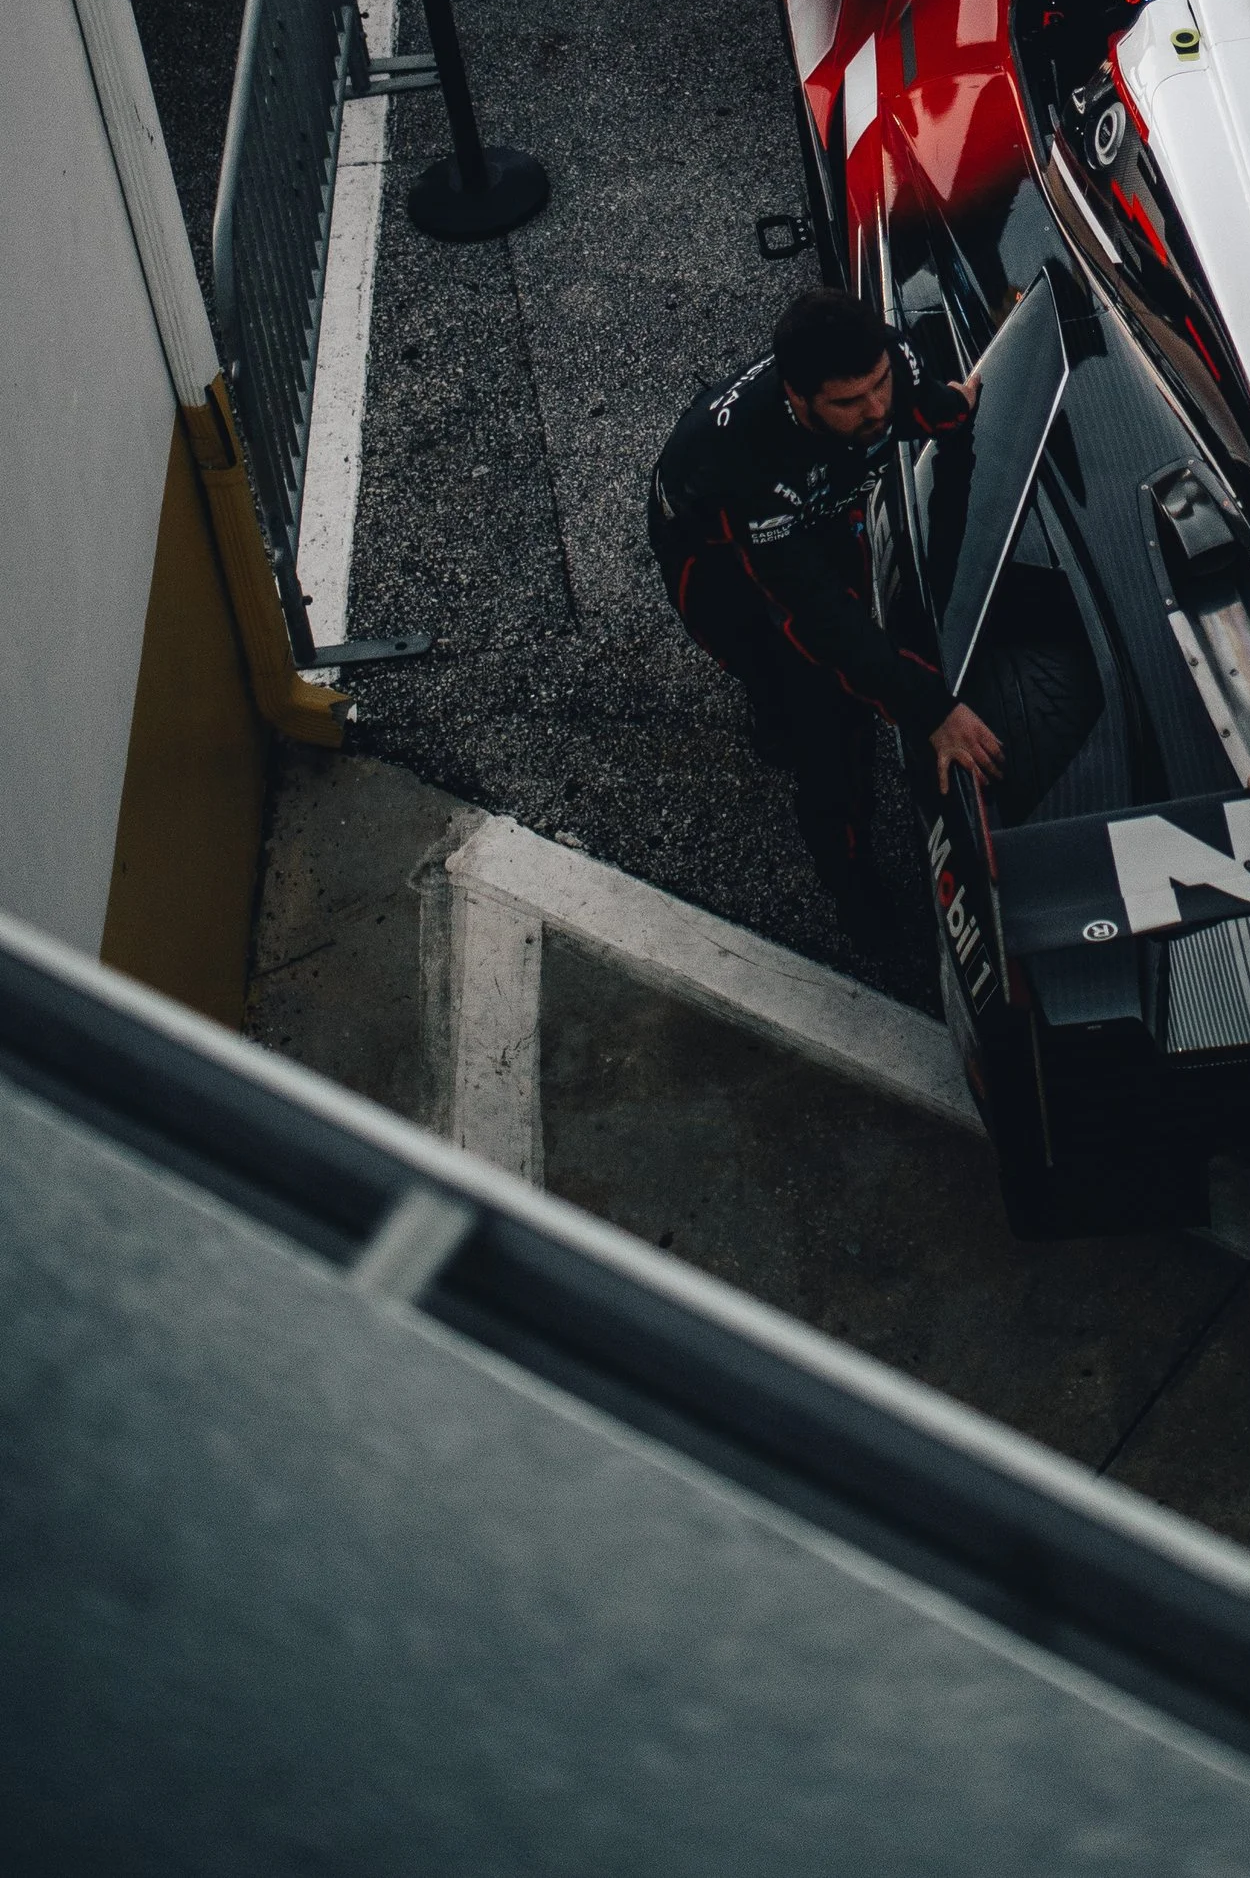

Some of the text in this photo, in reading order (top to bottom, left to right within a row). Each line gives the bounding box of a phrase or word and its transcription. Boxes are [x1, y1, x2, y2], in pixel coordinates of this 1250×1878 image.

[751, 522, 797, 540] CADILLA
[752, 530, 792, 545] RACING
[928, 814, 993, 999] Mobil 1
